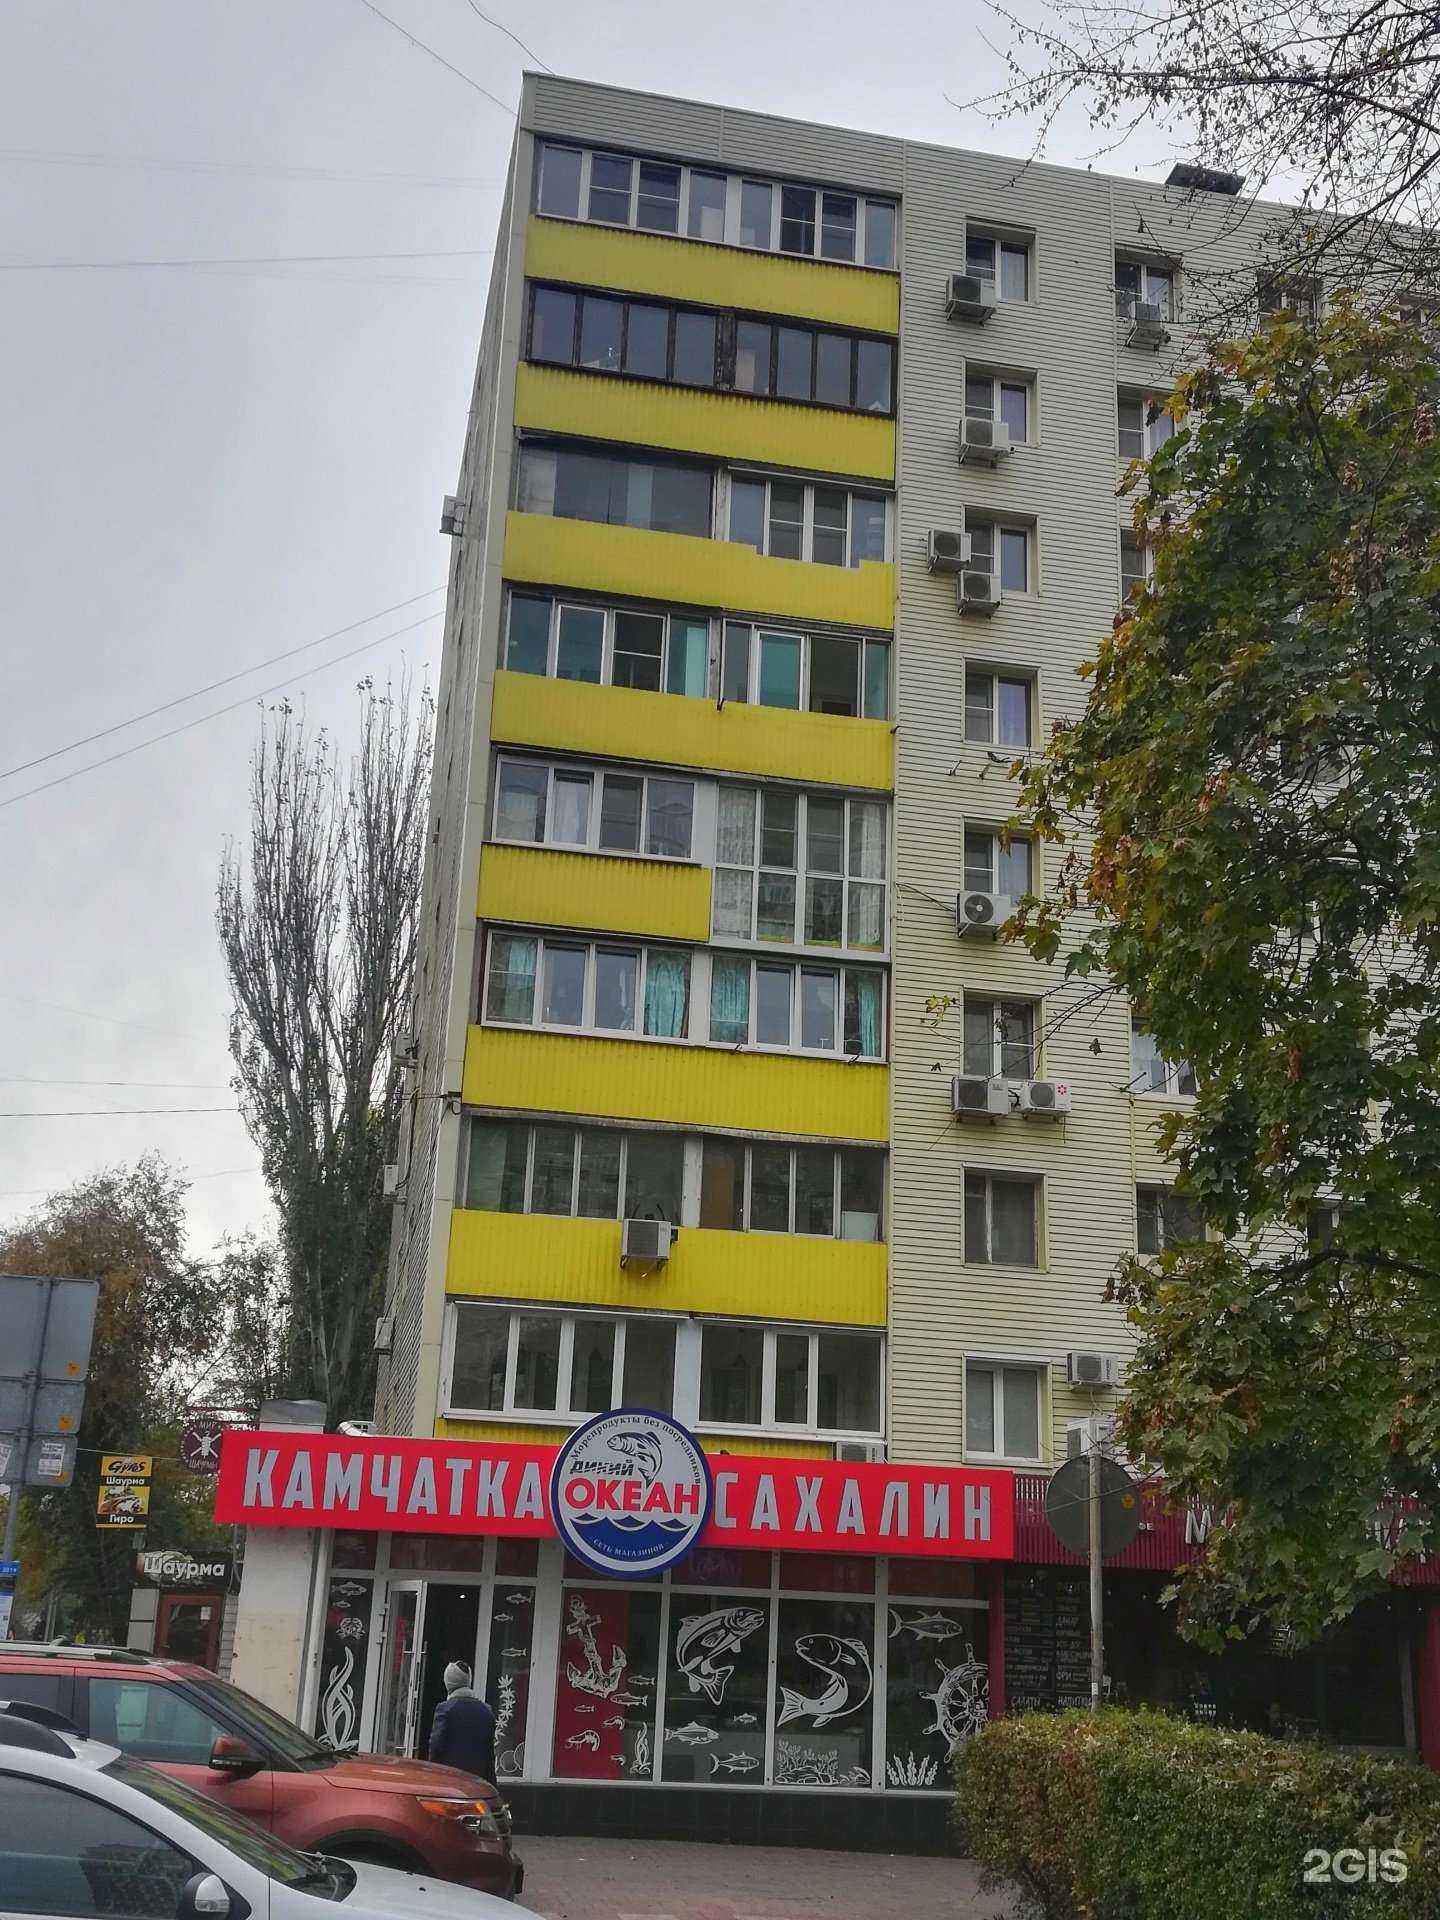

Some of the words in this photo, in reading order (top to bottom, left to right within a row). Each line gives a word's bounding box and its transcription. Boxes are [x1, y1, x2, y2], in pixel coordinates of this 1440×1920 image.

[644, 1416, 659, 1427] без
[106, 1476, 145, 1486] Шаурма
[243, 1448, 545, 1520] КАМЧАТКА
[564, 1477, 700, 1515] ОКЕАН
[714, 1471, 991, 1541] САХАЛИН
[109, 1514, 134, 1524] Гиро
[143, 1557, 225, 1579] Шаурма
